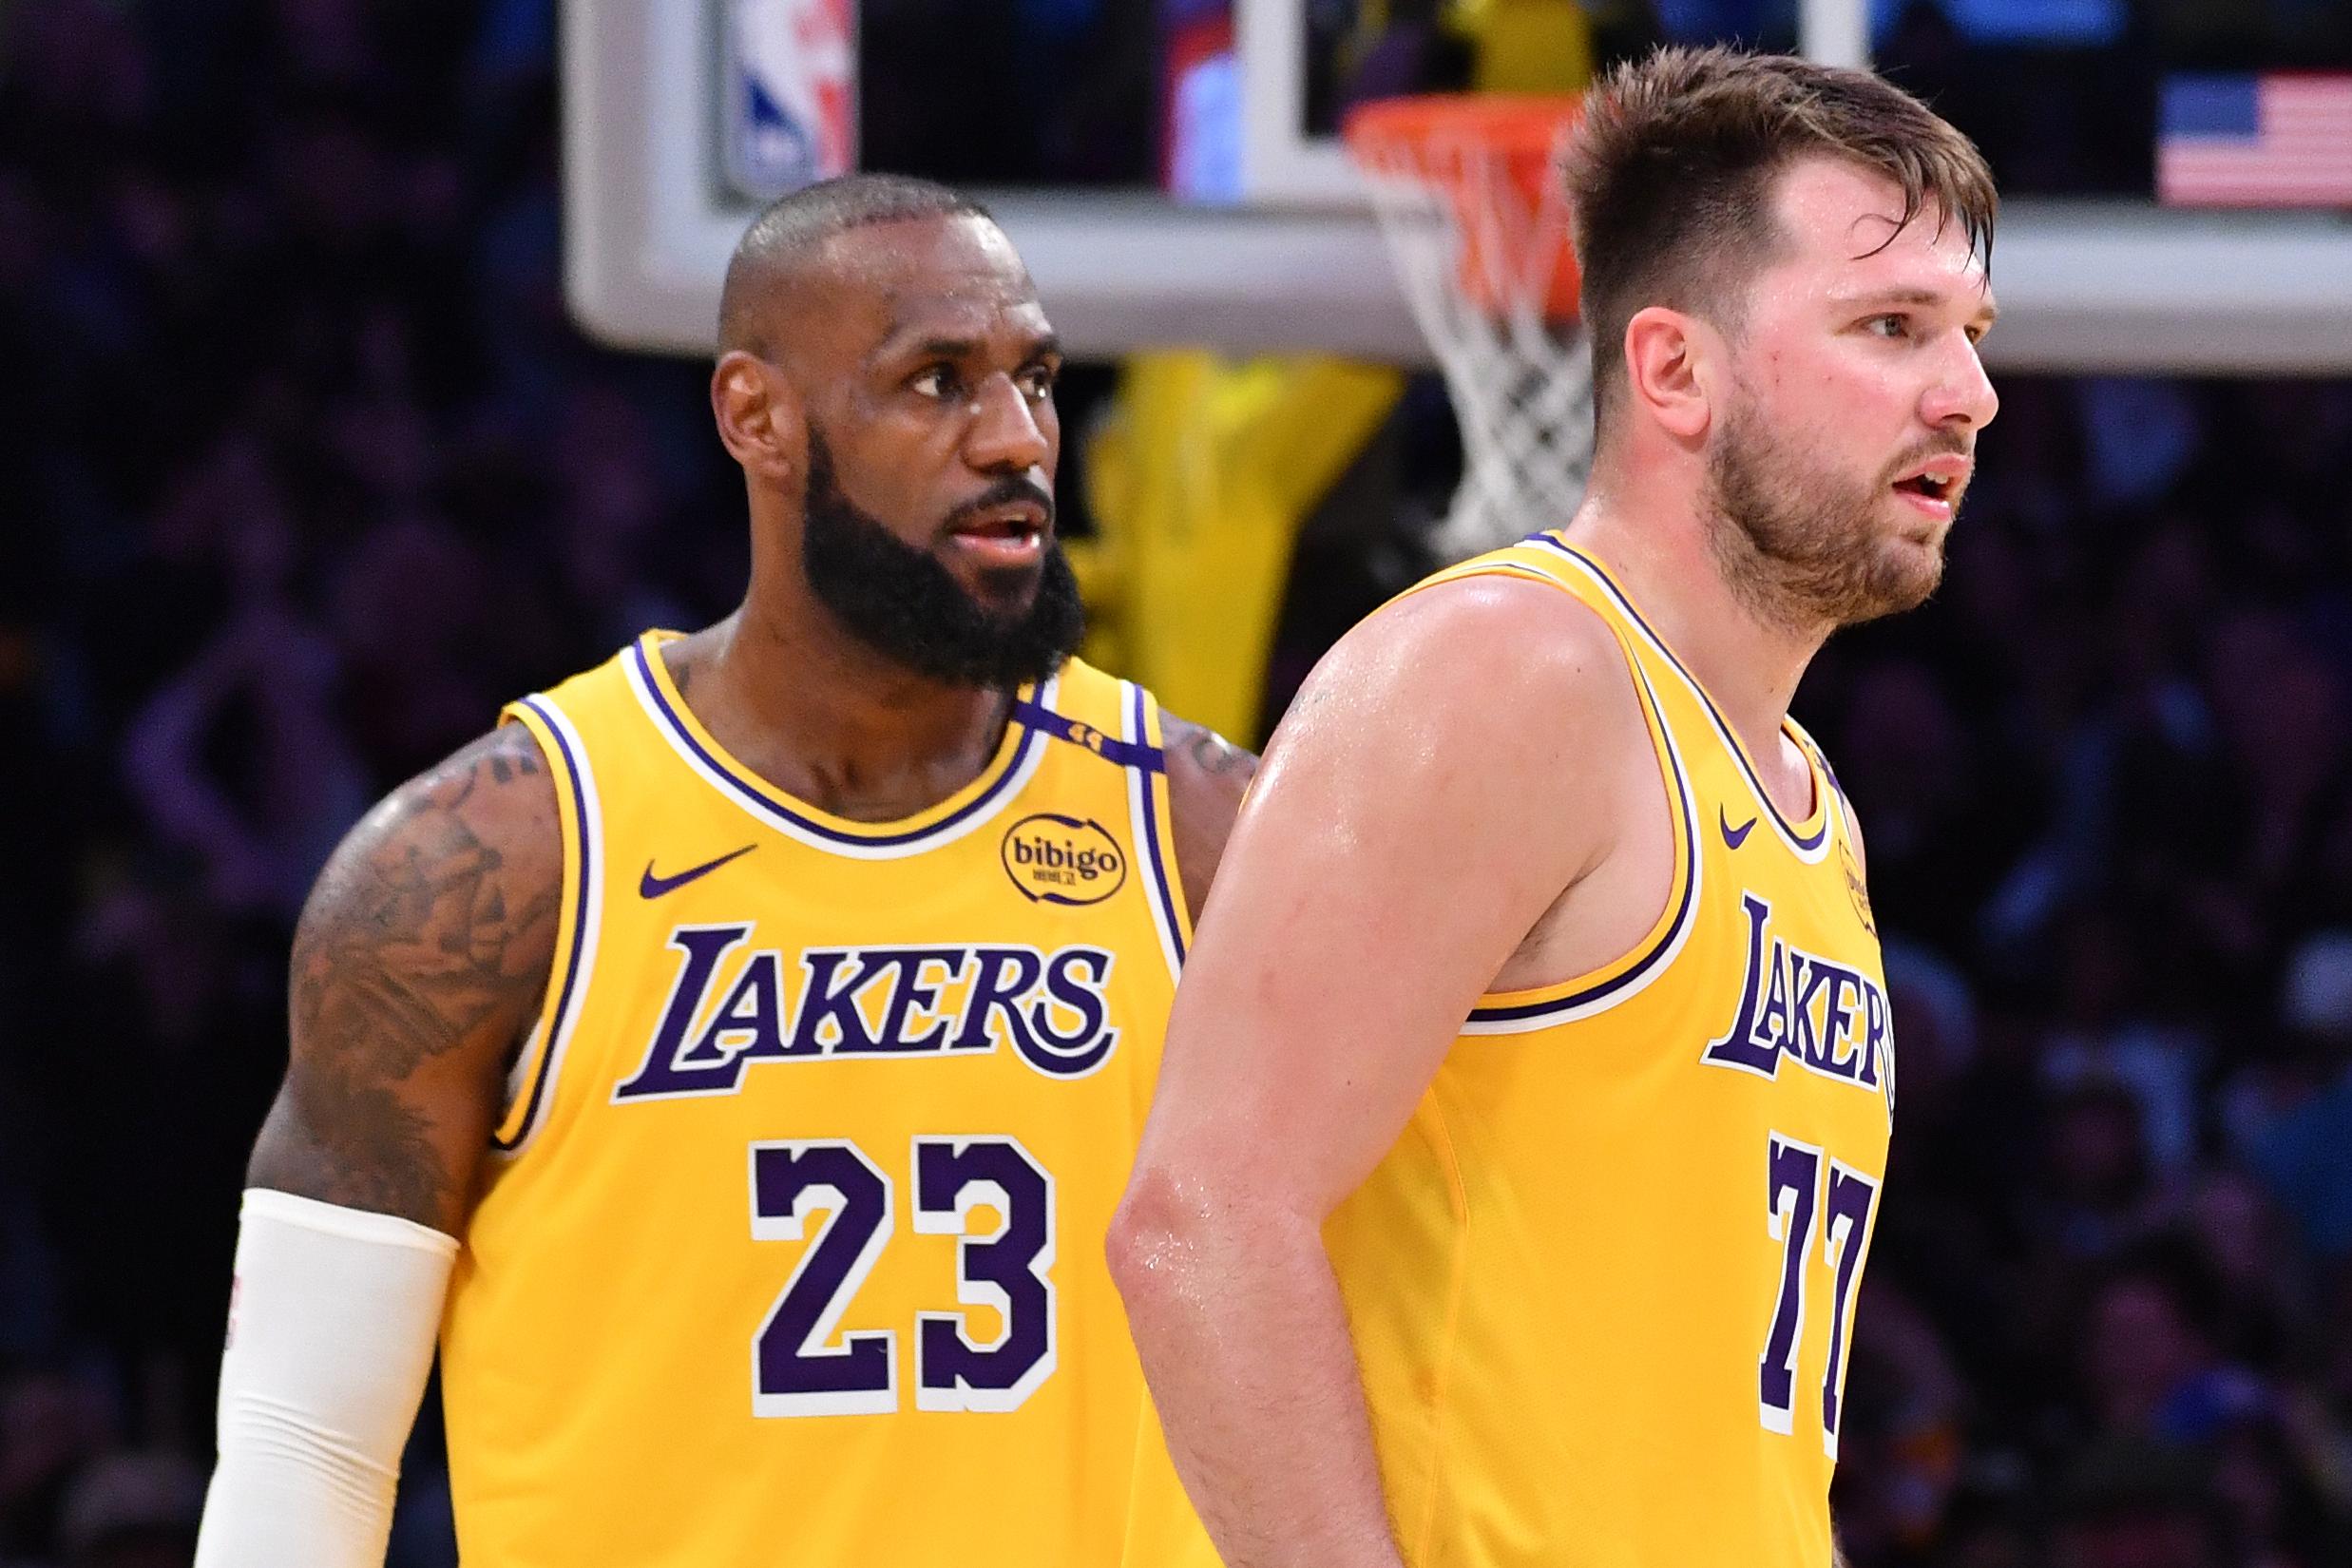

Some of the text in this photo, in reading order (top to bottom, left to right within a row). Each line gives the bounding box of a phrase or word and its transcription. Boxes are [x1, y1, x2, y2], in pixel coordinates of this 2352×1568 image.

[1013, 836, 1118, 880] bibigo
[609, 921, 1121, 1105] LAKERS
[1699, 889, 1895, 1134] LAKER
[747, 1135, 1058, 1418] 23
[1757, 1128, 1881, 1463] 77
